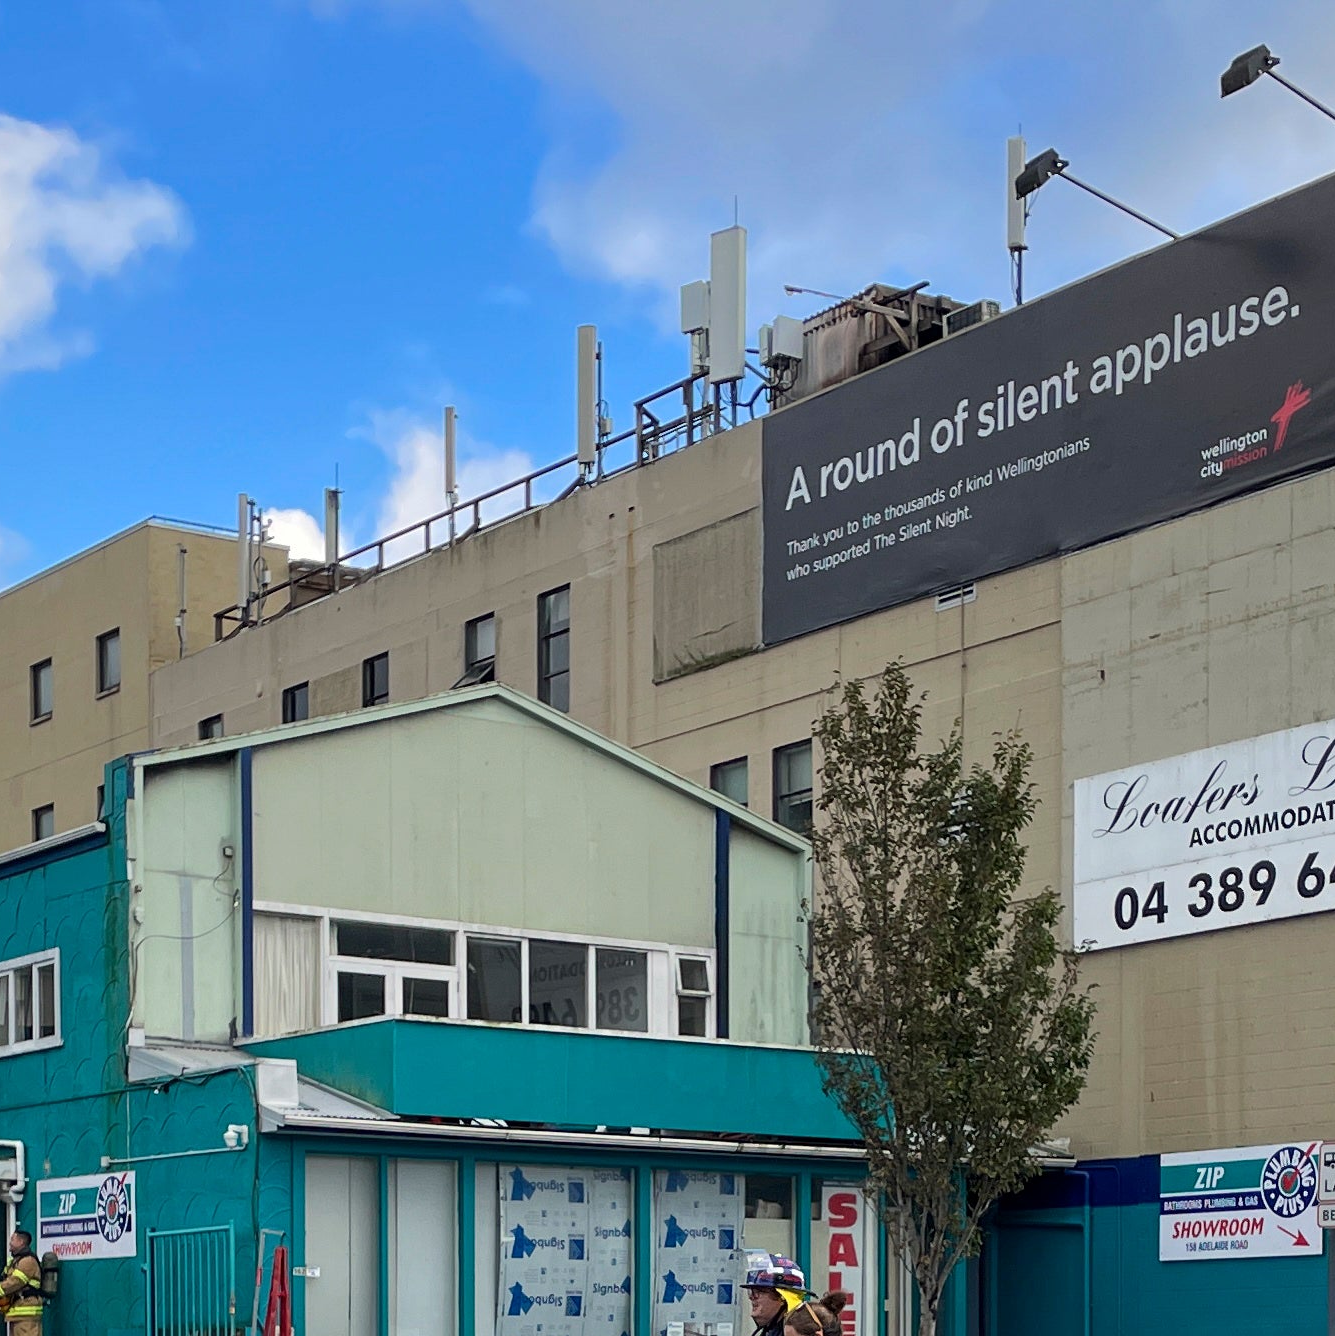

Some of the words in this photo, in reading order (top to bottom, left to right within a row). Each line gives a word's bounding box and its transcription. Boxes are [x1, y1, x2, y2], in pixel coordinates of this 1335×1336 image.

[785, 465, 812, 511] A
[820, 418, 920, 498] round
[930, 399, 969, 454] of
[977, 360, 1080, 438] silent
[1089, 285, 1301, 395] applause.
[1201, 428, 1268, 461] wellington
[786, 529, 820, 556] Thank
[823, 527, 844, 546] you
[847, 519, 859, 534] to
[862, 511, 881, 529] the
[884, 488, 945, 521] thousands
[949, 483, 963, 499] of
[966, 469, 993, 494] kind
[997, 436, 1090, 482] Wellingtonians
[786, 556, 810, 581] who
[813, 539, 870, 575] supported
[874, 528, 896, 552] The
[899, 517, 931, 542] Silent
[936, 506, 973, 531] Night.
[1092, 759, 1262, 839] Loafers
[1114, 880, 1168, 931] 04
[1187, 860, 1276, 919] 389
[1194, 1166, 1225, 1189] ZIP
[1264, 1149, 1315, 1190] PLUMBING
[59, 1193, 76, 1214] ZIP
[1238, 1196, 1243, 1206] &
[1245, 1195, 1258, 1206] GAS
[1273, 1197, 1305, 1216] PLUS
[1172, 1217, 1264, 1239] SHOWROOM
[1199, 1240, 1228, 1251] ADELAIDE
[1230, 1239, 1248, 1250] ROAD
